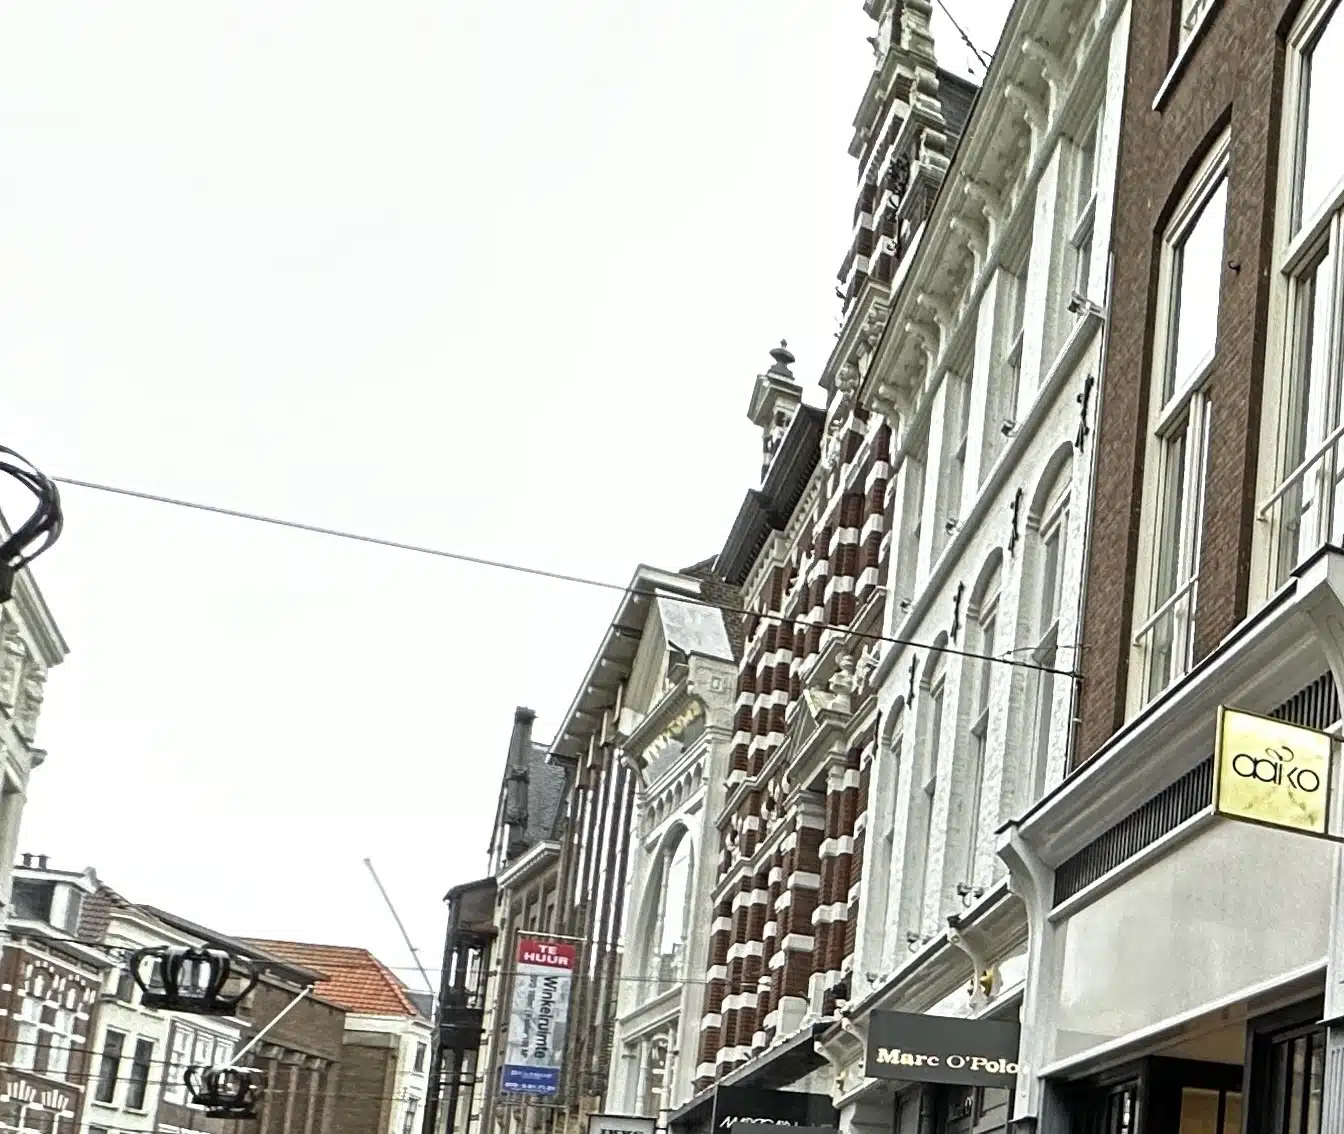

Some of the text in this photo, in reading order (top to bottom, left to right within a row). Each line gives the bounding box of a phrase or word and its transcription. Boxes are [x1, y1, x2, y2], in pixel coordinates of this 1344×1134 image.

[1232, 746, 1320, 792] aaiko
[524, 953, 568, 966] HUUR
[538, 944, 557, 955] TE
[534, 975, 558, 1059] Winkelruimte
[876, 1048, 1020, 1075] Marc O'Polo
